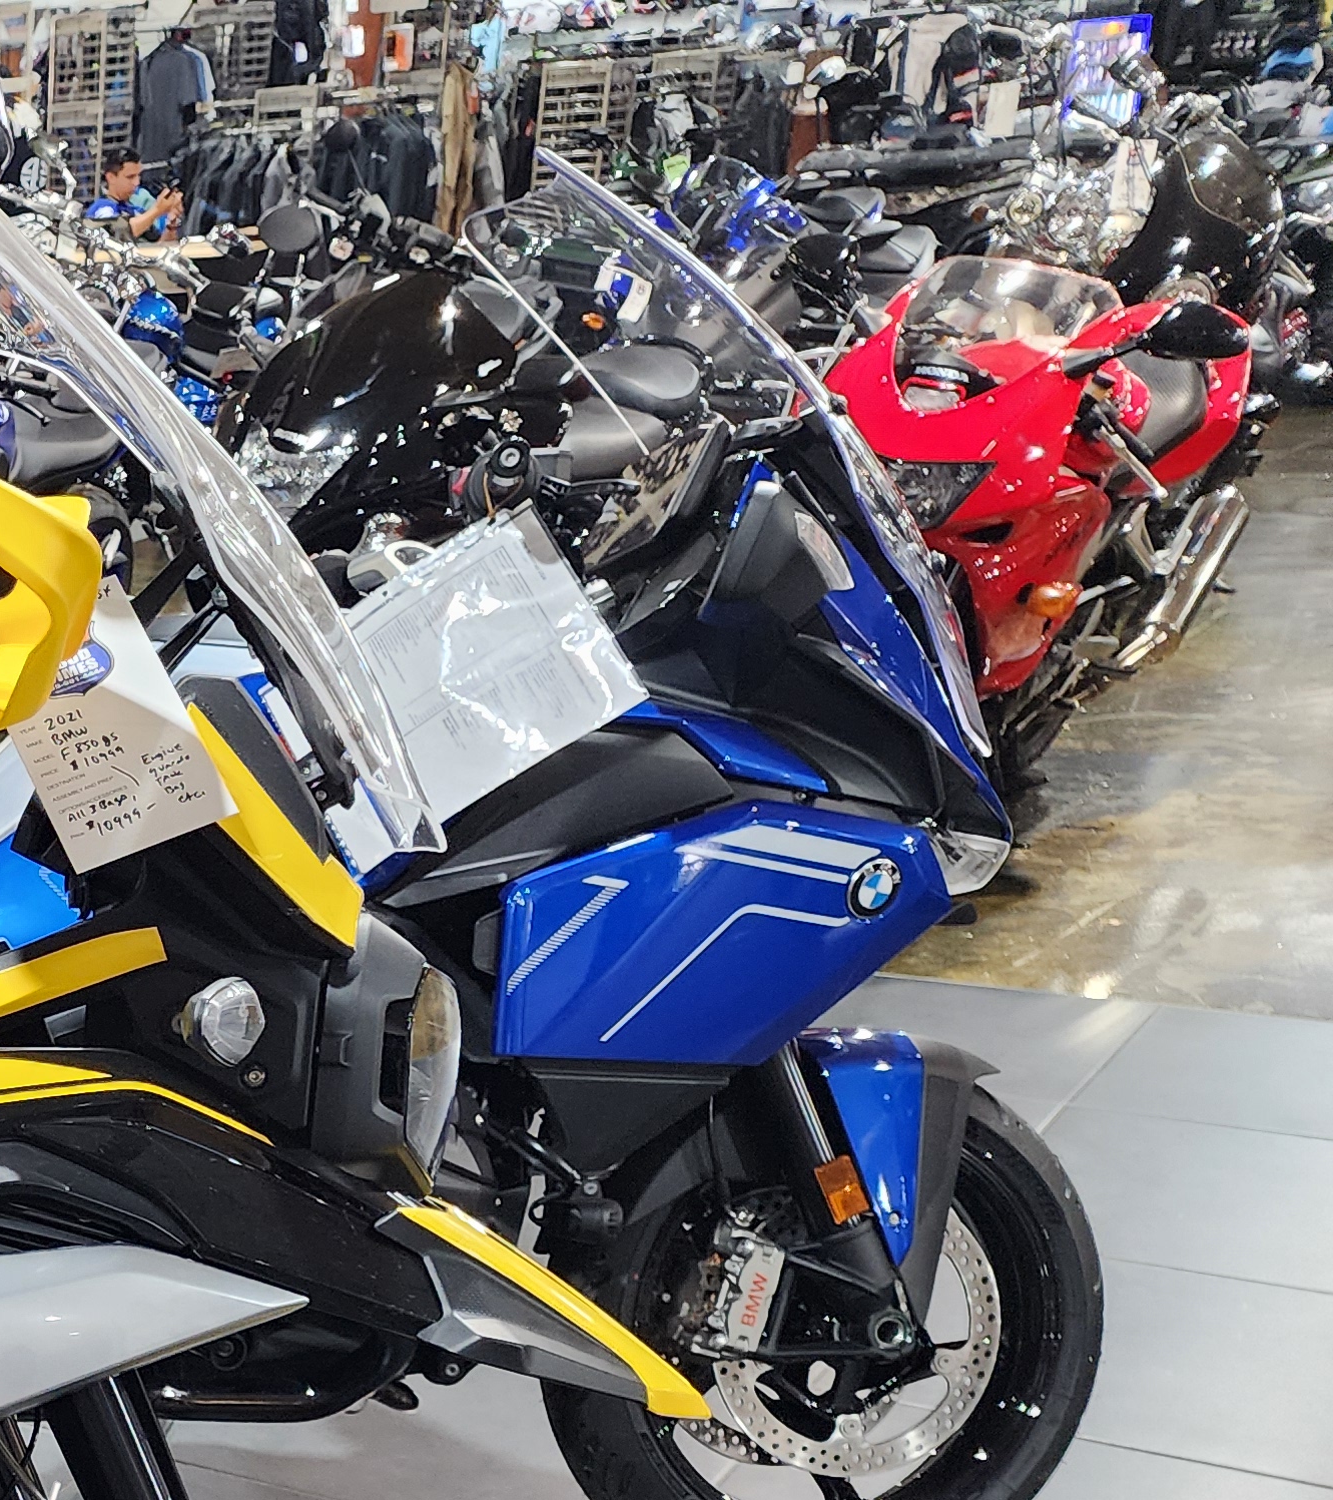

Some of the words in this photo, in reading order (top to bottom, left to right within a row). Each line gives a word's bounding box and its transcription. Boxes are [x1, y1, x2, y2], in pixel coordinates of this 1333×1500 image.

[43, 708, 84, 732] 2021
[33, 753, 56, 764] MODEL
[60, 747, 71, 761] F
[75, 738, 99, 754] 850
[40, 768, 60, 779] PRICE
[46, 773, 86, 792] DESTINATION
[51, 787, 84, 803] ASSEMBLY
[84, 782, 97, 791] AND
[97, 776, 115, 787] PREP
[740, 1272, 768, 1328] BMW
